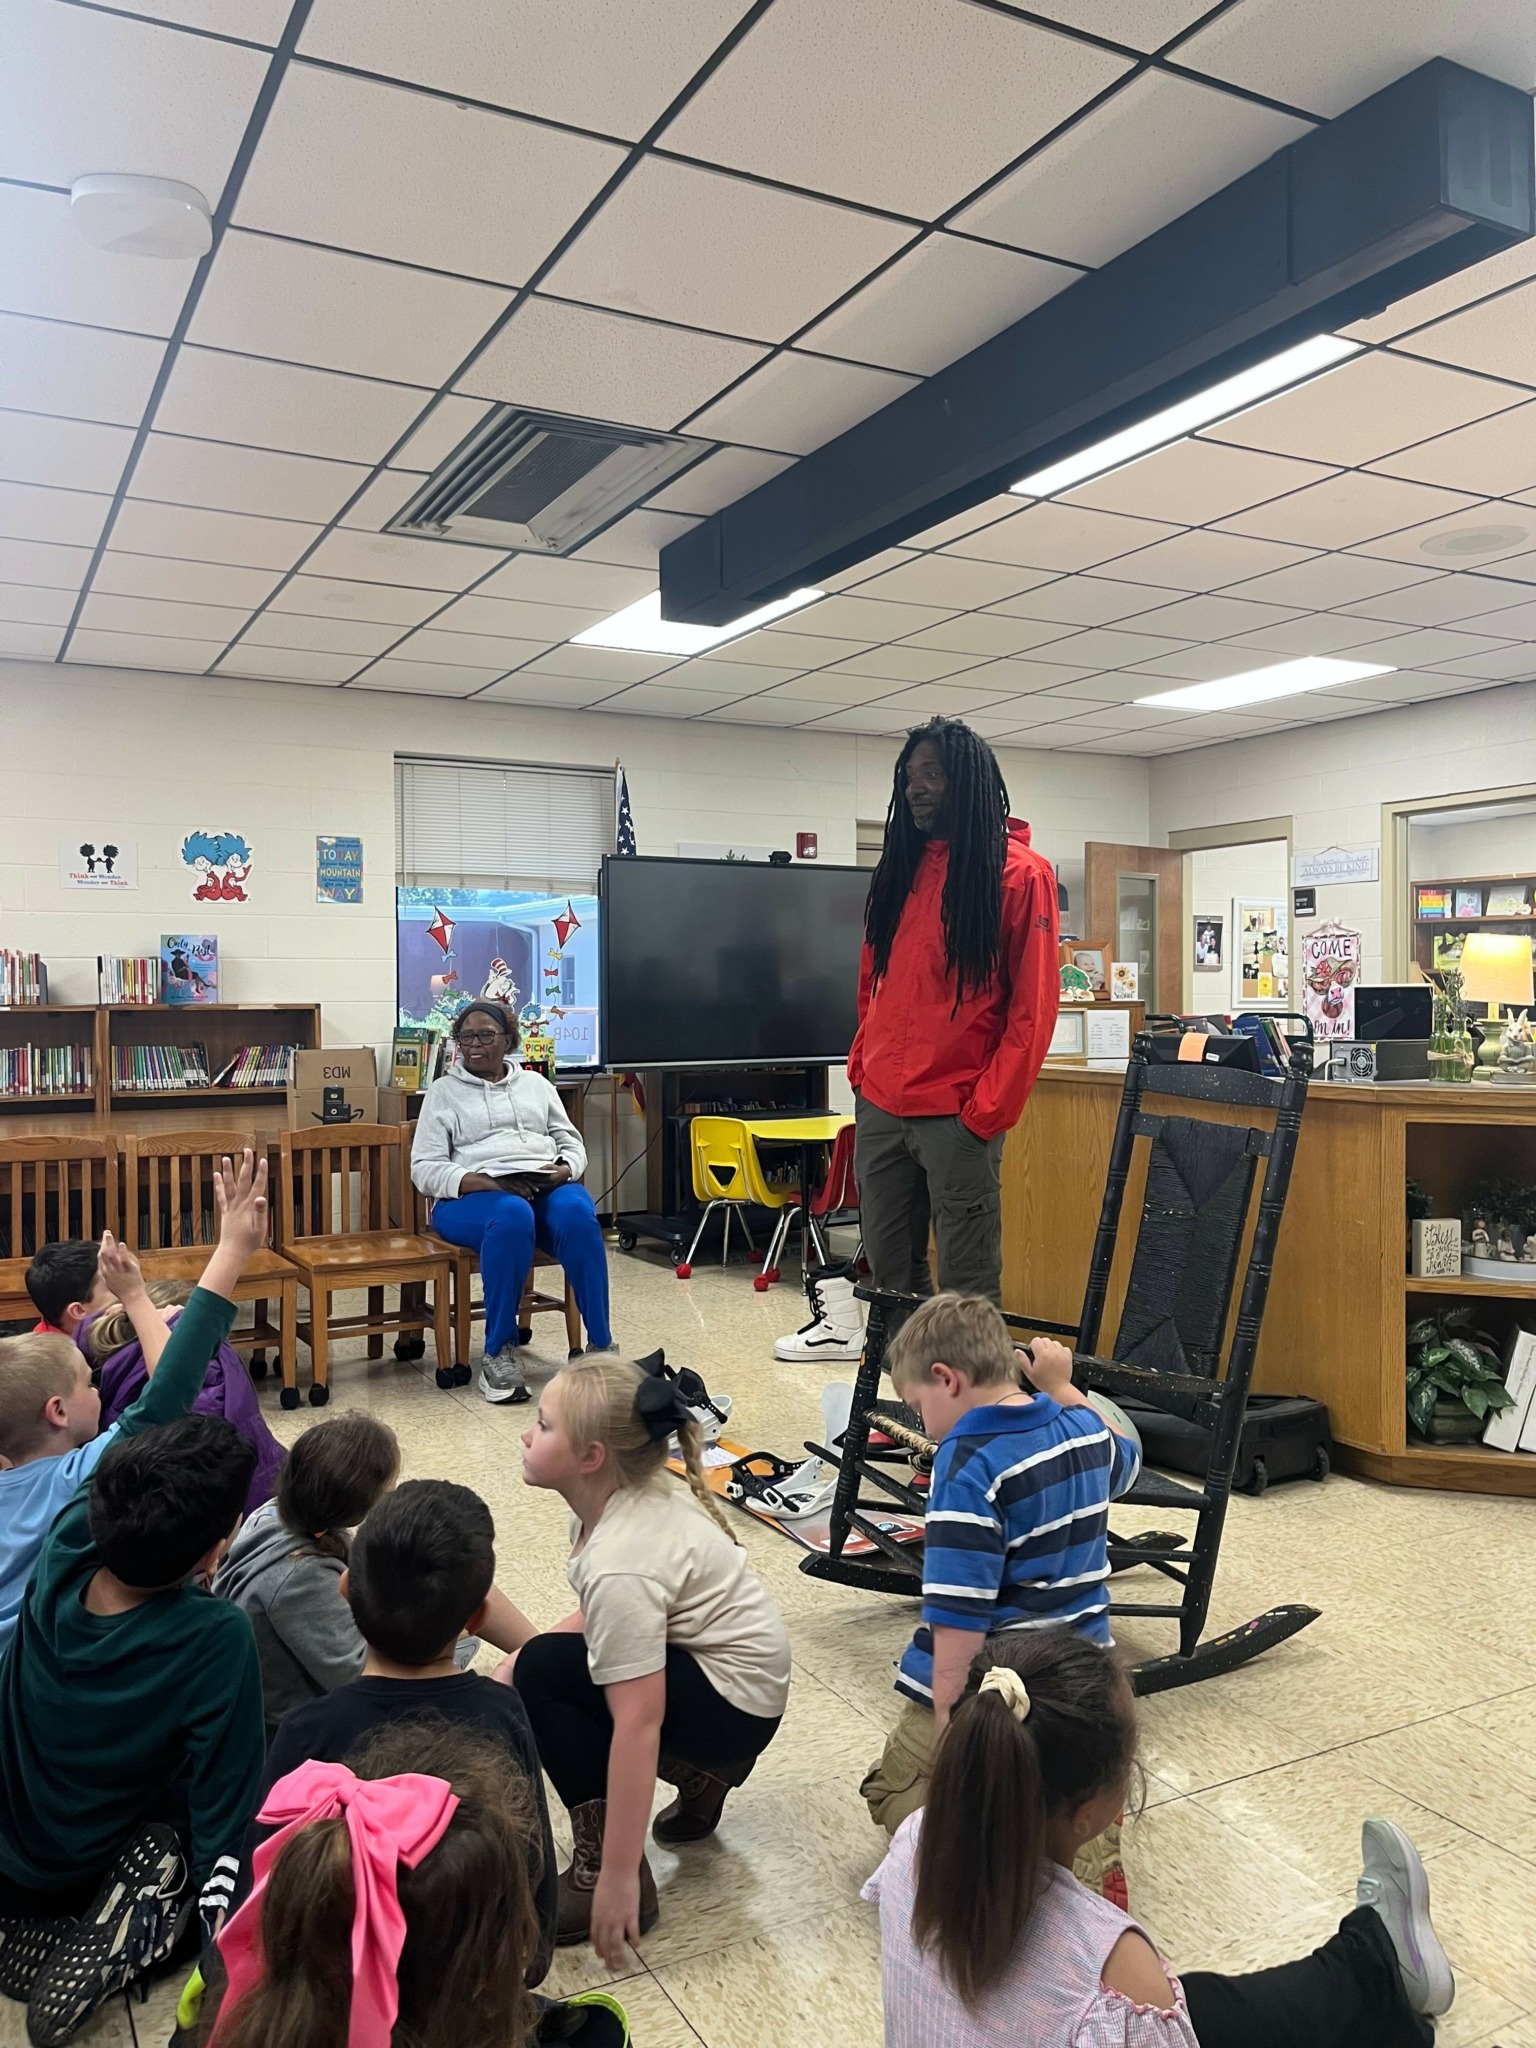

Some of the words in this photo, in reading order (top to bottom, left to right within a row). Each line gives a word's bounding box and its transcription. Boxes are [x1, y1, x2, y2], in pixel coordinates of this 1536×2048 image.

[322, 849, 358, 861] TODAY
[320, 868, 361, 877] MOUNTAIN
[1302, 864, 1333, 876] ALWAYS
[1346, 861, 1368, 872] KIND
[1311, 938, 1352, 960] COME
[1331, 1019, 1351, 1036] in!
[525, 1043, 555, 1054] PICNIC
[323, 1066, 351, 1079] MD3
